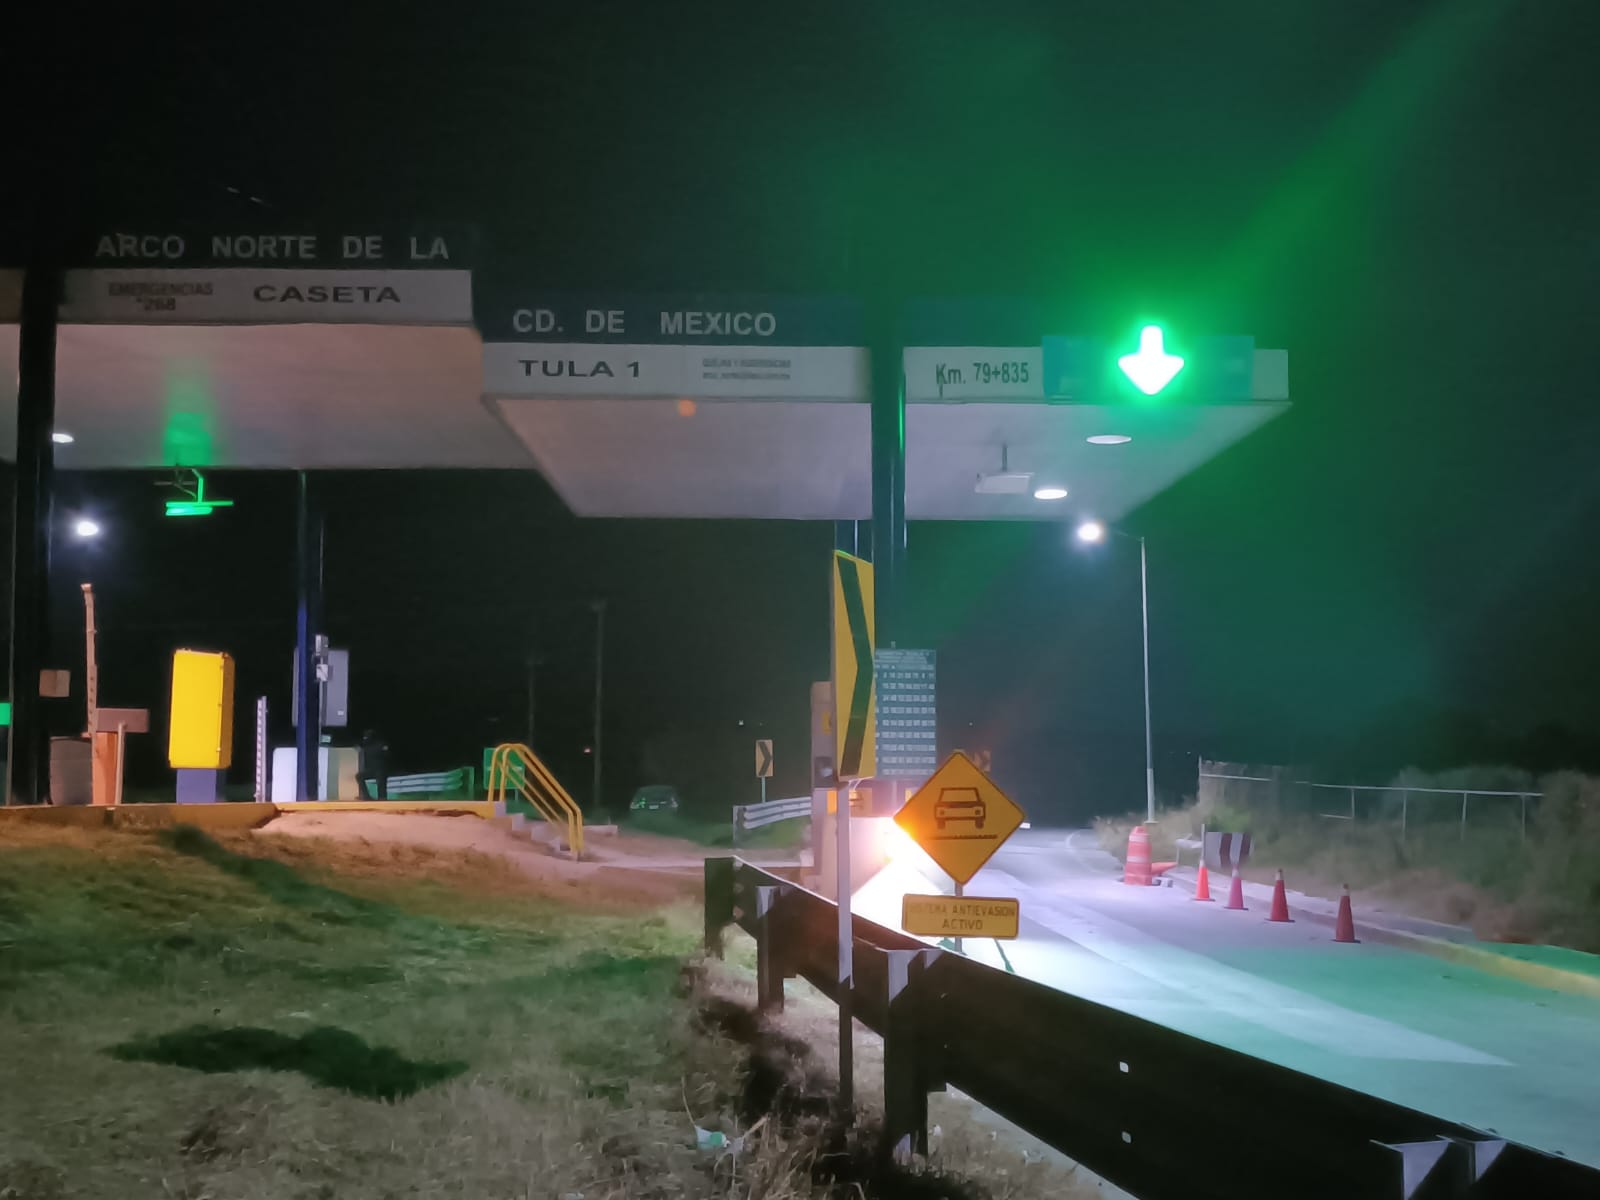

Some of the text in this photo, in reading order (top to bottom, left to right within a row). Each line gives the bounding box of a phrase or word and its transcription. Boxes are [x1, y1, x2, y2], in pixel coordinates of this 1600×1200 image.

[95, 235, 450, 260] ARCO NORTE DE LA
[253, 285, 401, 304] CASETA
[512, 308, 777, 336] CD. DE MEXICO
[518, 359, 641, 378] TULA 1
[936, 362, 1029, 385] Km. 79+835
[942, 918, 983, 930] ACTIVO
